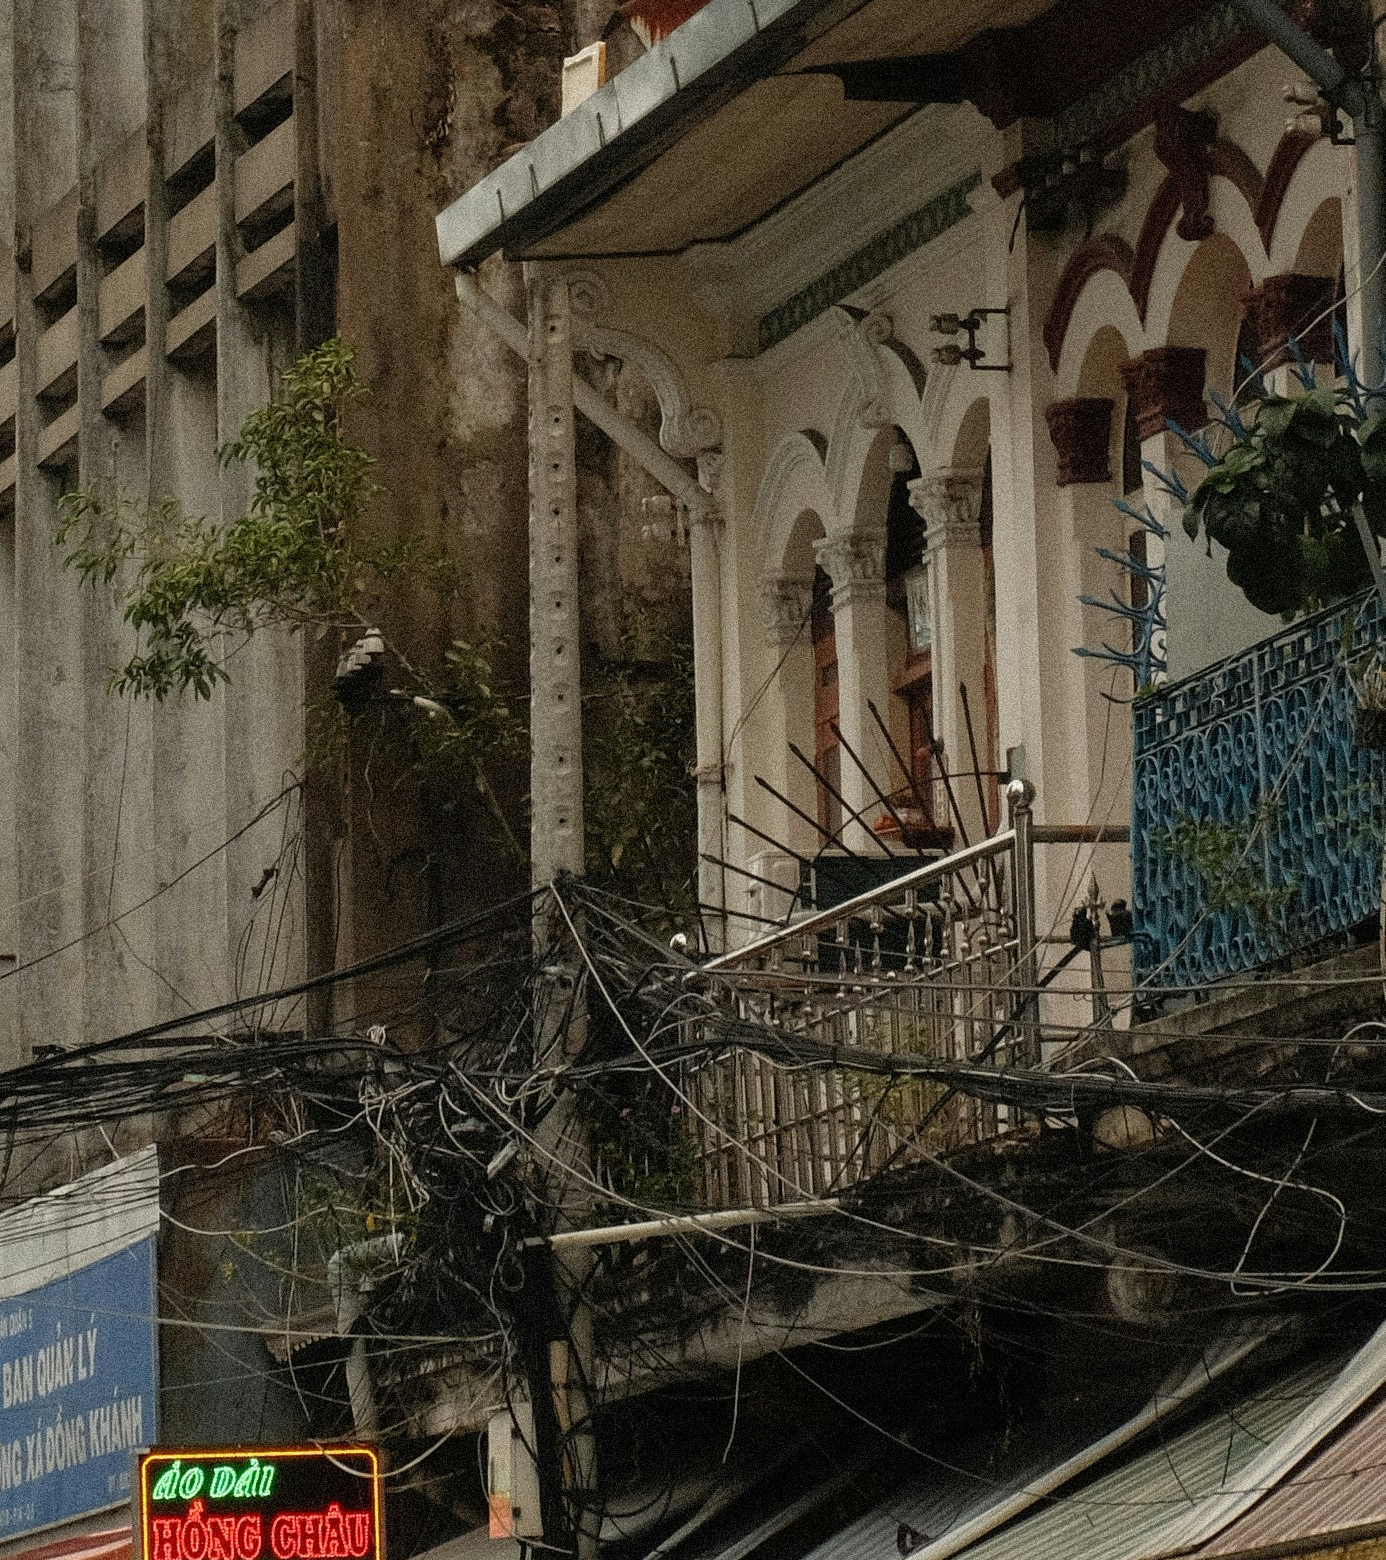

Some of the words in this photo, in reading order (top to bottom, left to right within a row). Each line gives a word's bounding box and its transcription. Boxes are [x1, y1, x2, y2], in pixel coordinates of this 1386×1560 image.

[1, 1352, 34, 1409] BAN
[36, 1320, 75, 1399] QUẢN
[77, 1312, 99, 1382] LÝ
[25, 1417, 44, 1482] XÁ
[44, 1404, 87, 1475] ĐỒNG
[89, 1386, 144, 1457] KHÁNH
[151, 1459, 206, 1501] ÁO
[208, 1457, 276, 1498] DÀI
[271, 1502, 371, 1560] CHÂU
